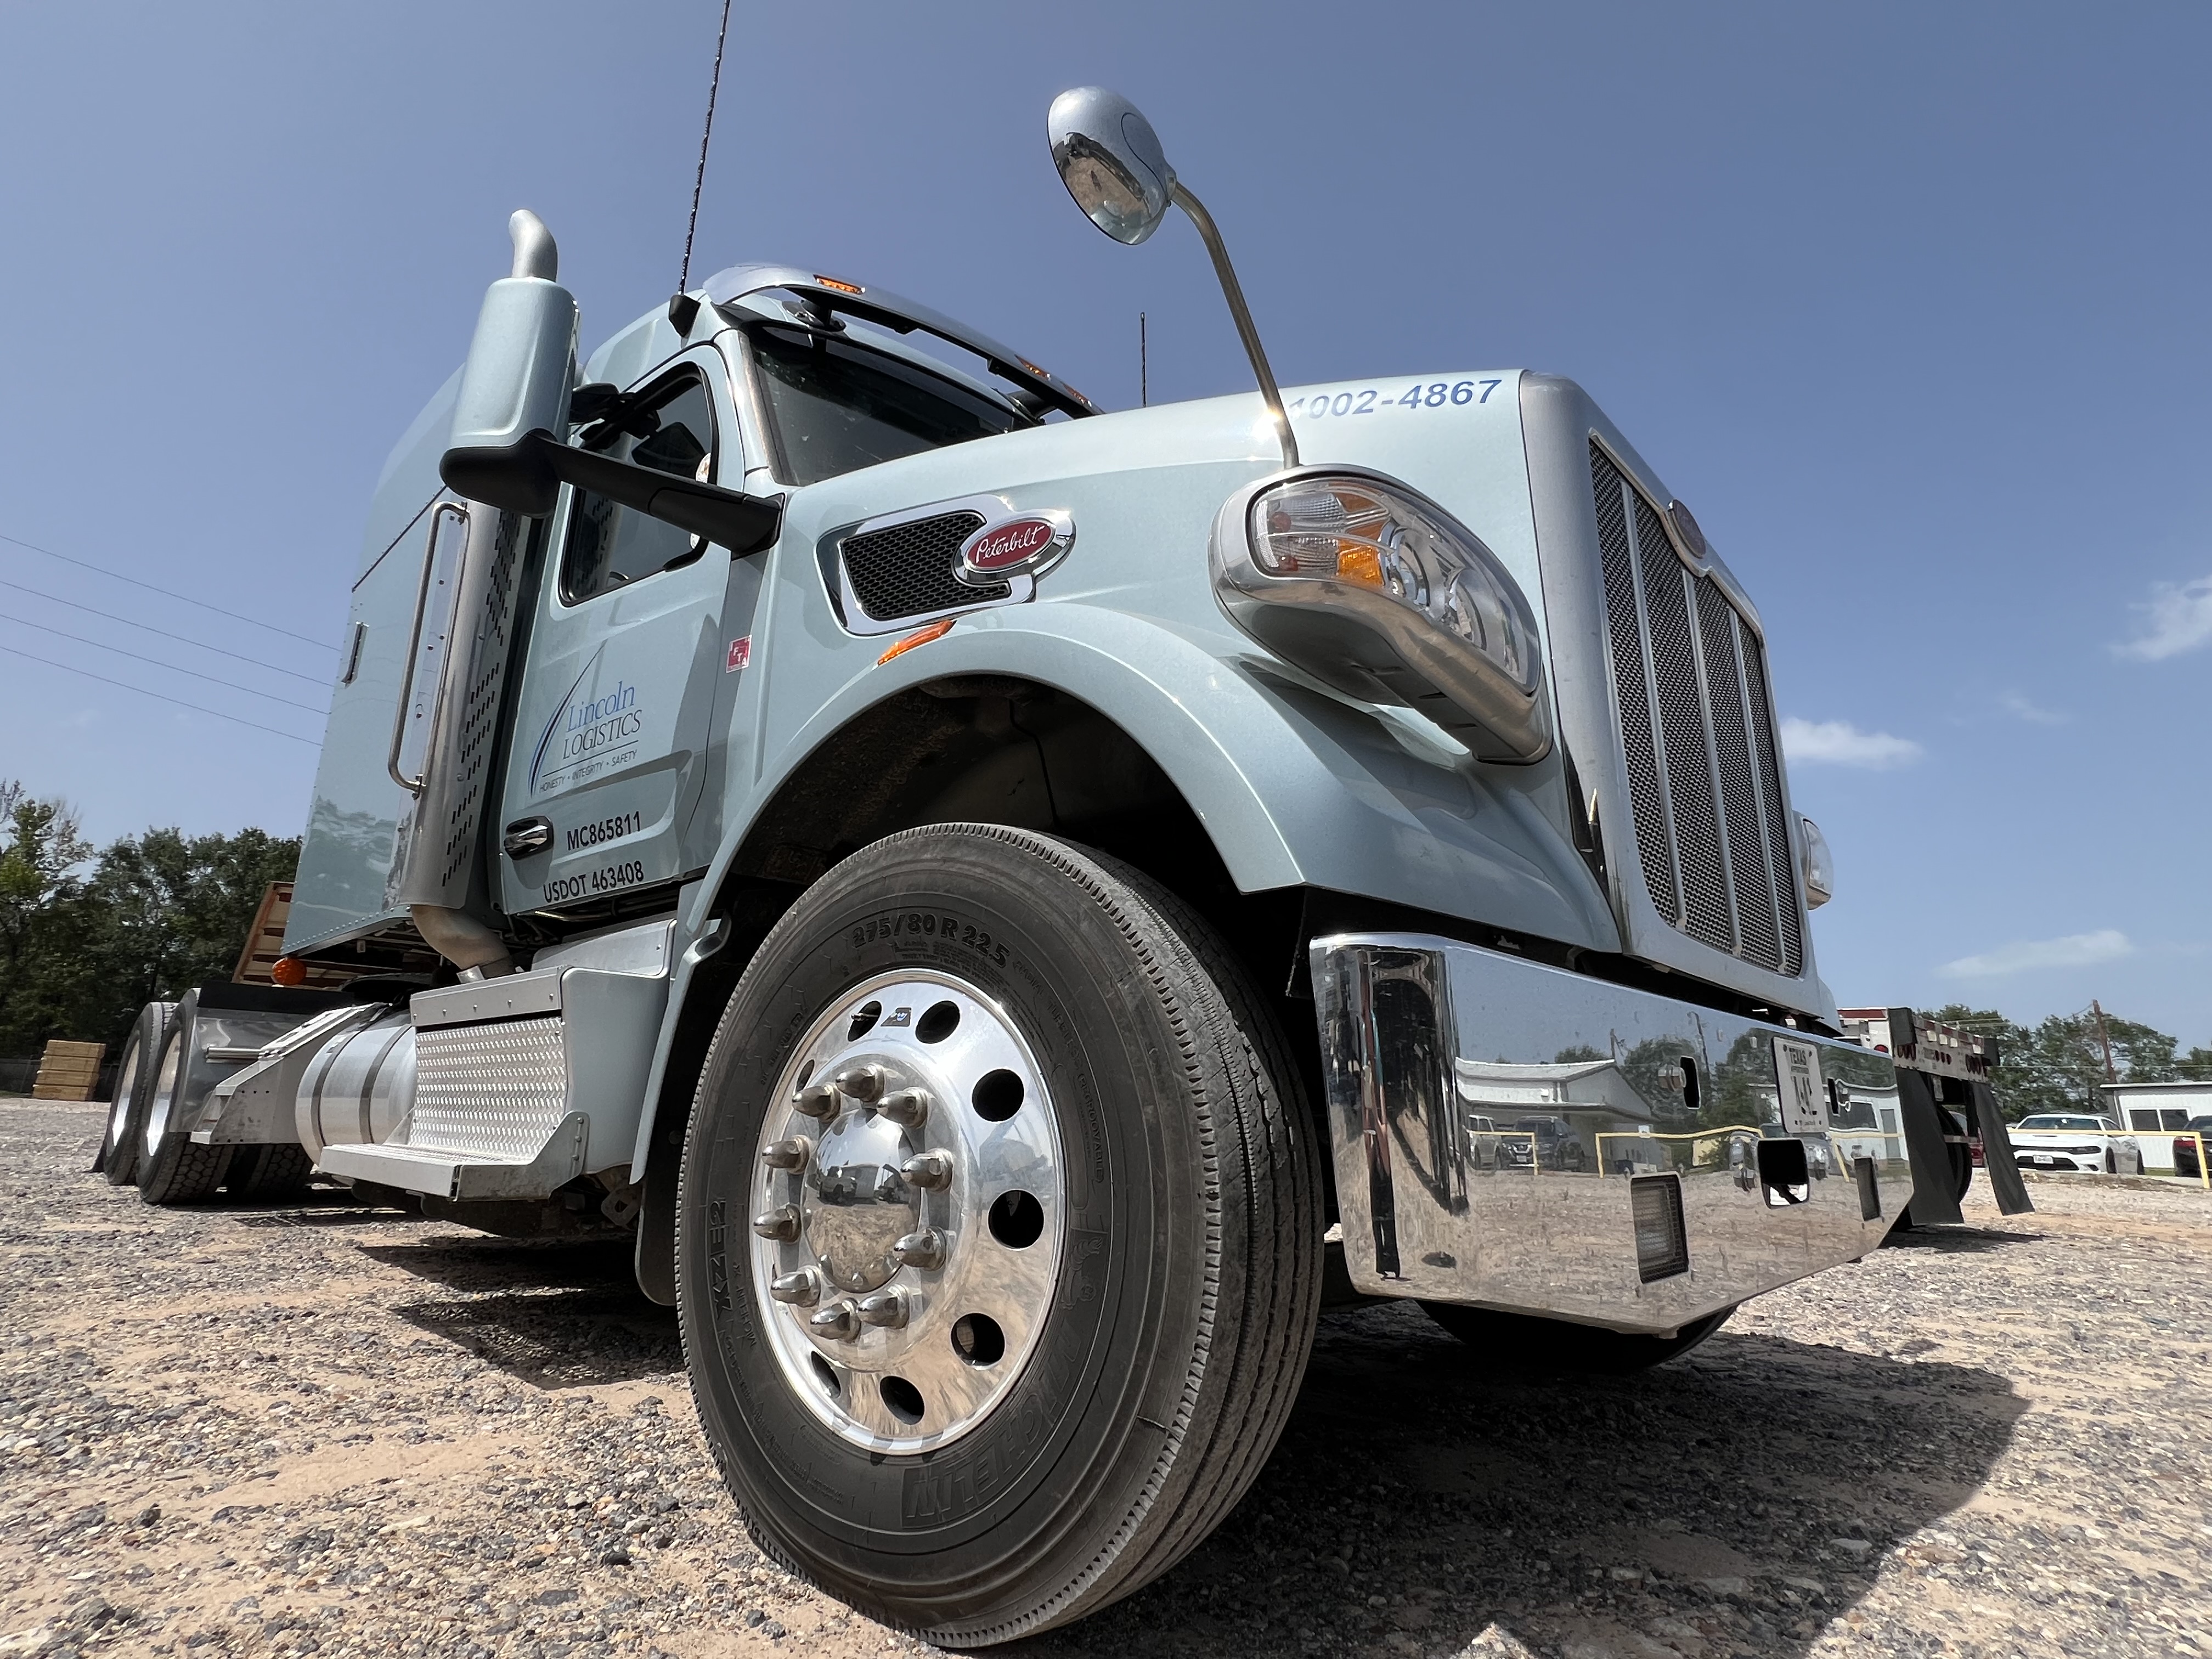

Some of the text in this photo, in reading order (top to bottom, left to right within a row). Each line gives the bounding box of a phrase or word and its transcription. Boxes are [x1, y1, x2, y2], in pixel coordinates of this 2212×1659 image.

[975, 526, 1045, 563] Peterbilt
[566, 680, 635, 732] Lincoln
[562, 709, 642, 759] LOGISTICS
[539, 749, 637, 793] HONESTY INTEGRITY SAFETY
[567, 810, 641, 850] MC865811
[543, 860, 644, 903] USDOT 463408
[853, 913, 936, 949] 275/80
[940, 916, 960, 941] R
[962, 924, 1011, 969] 22.5
